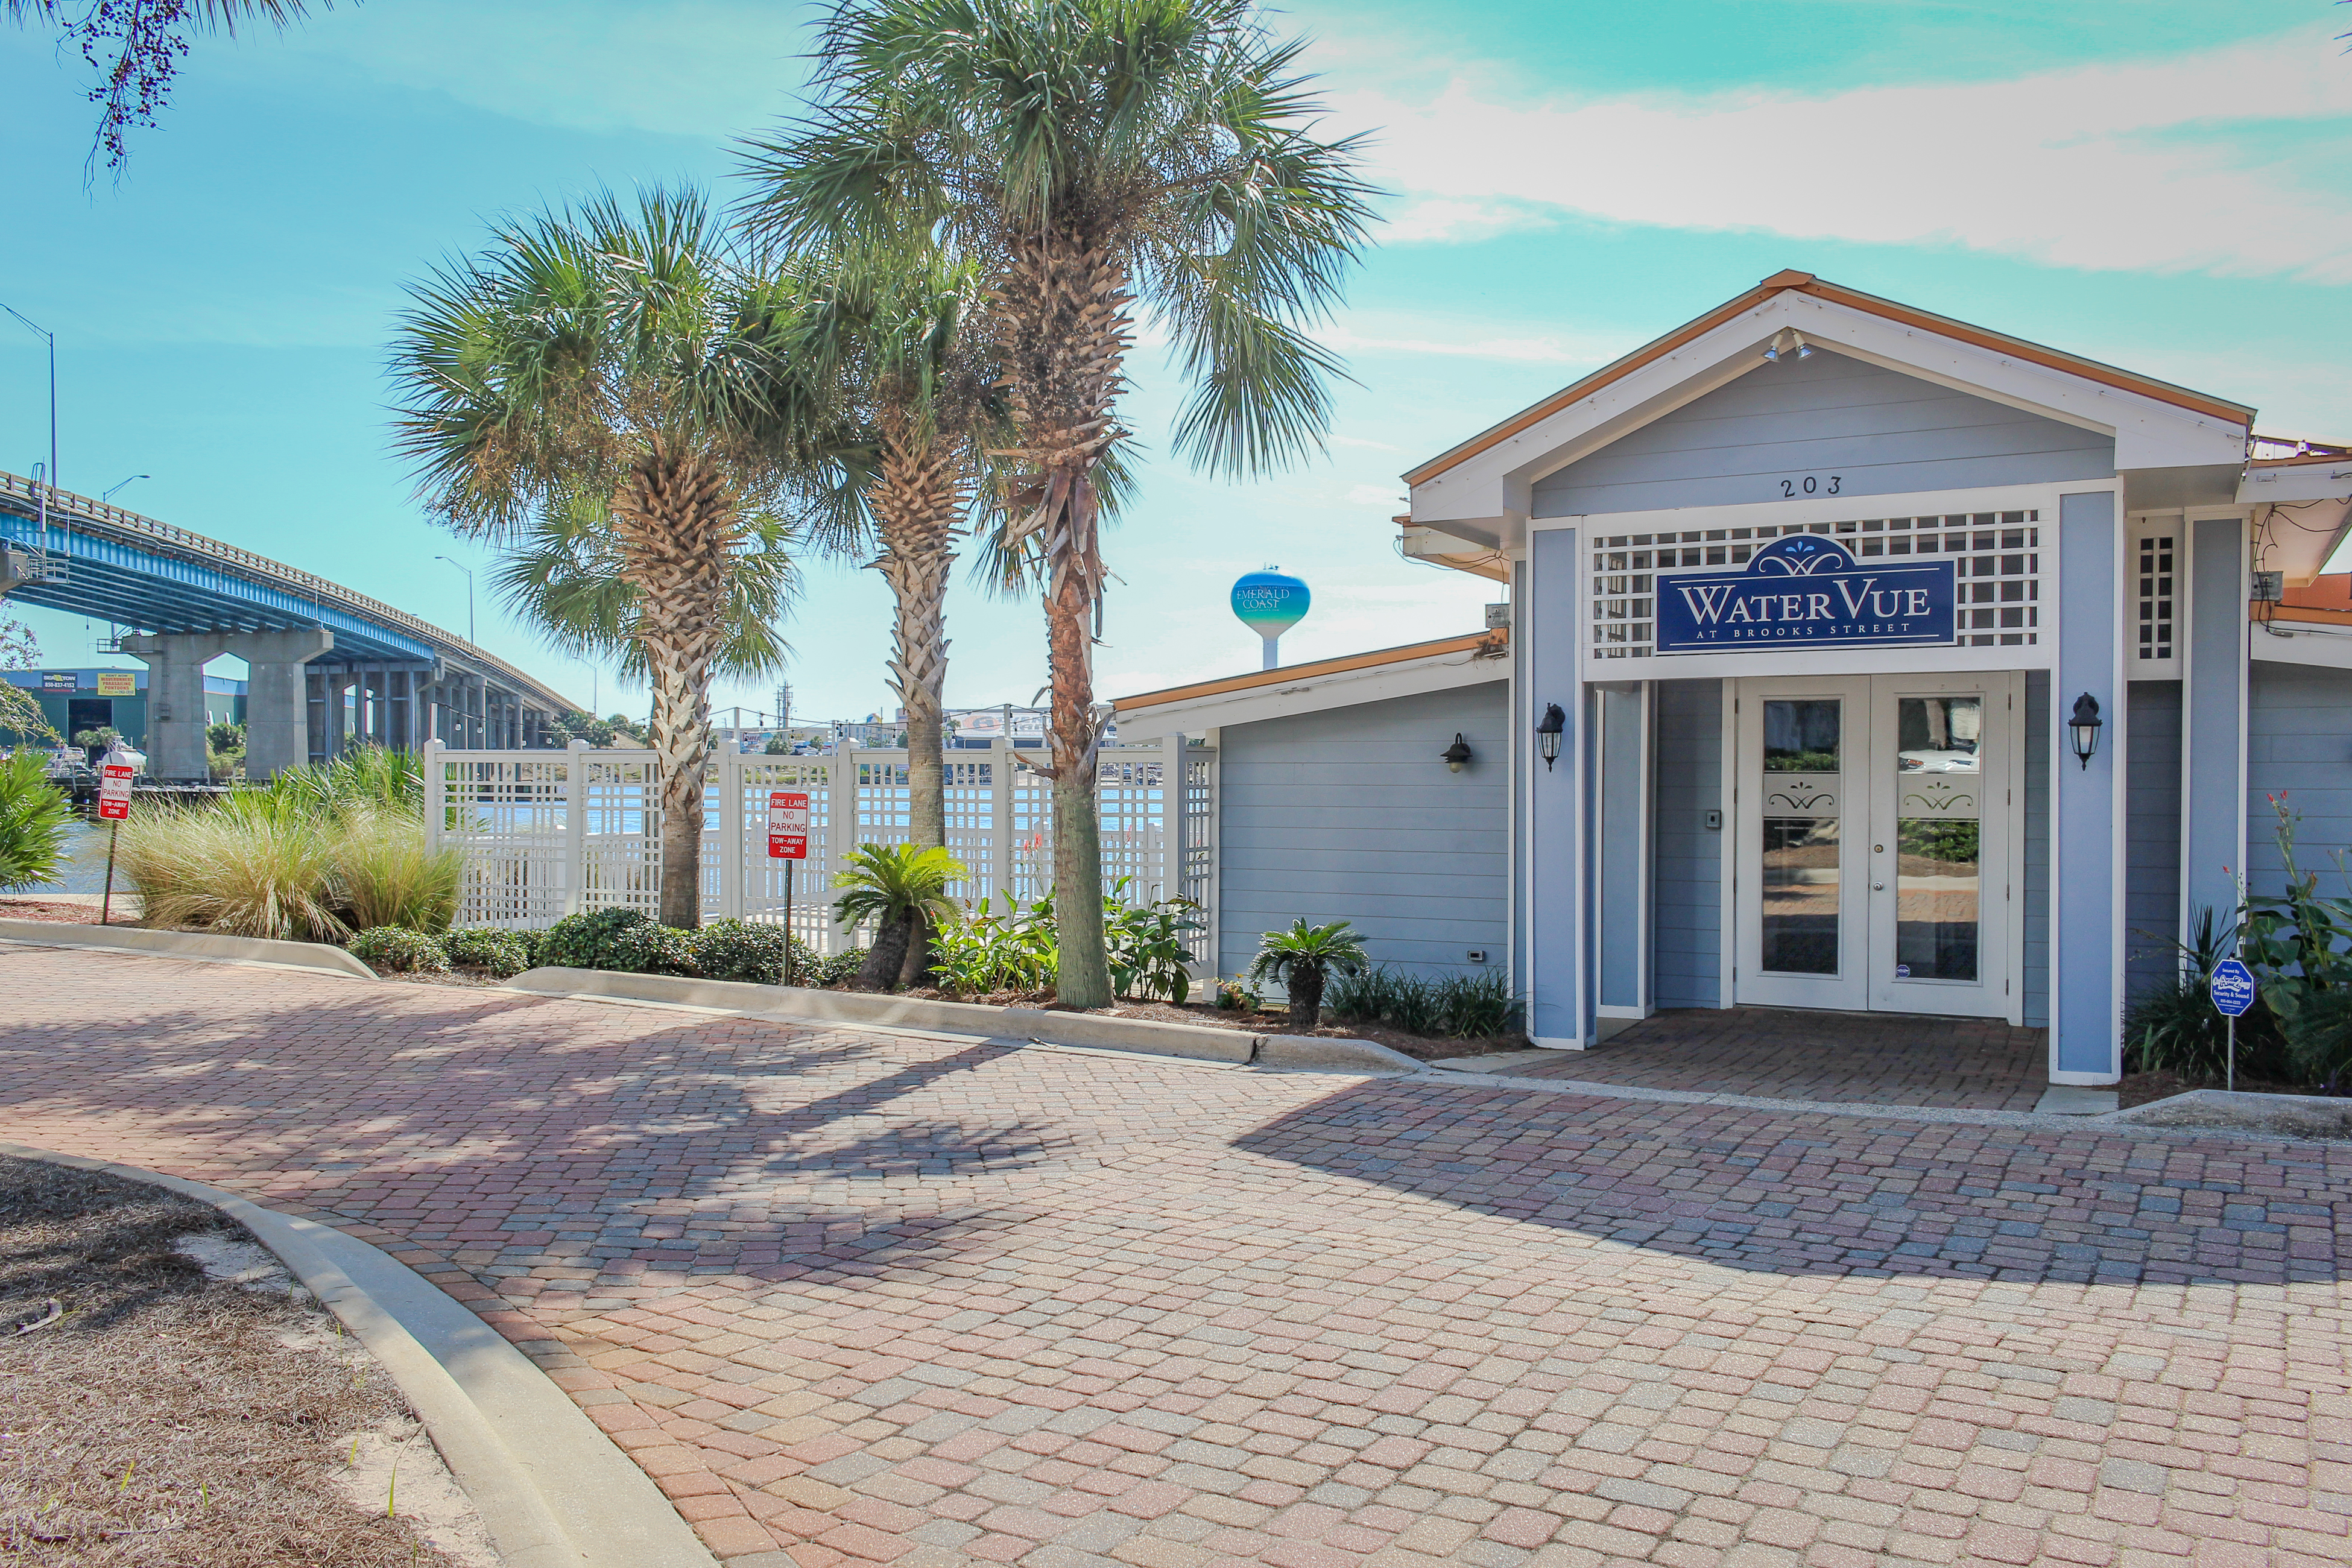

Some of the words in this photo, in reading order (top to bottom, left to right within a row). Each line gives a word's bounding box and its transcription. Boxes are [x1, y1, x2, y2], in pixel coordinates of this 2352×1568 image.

[1780, 476, 1842, 498] 203
[1237, 589, 1290, 599] EMERALD
[1243, 599, 1280, 609] COAST
[1697, 630, 1717, 639] AT
[1734, 627, 1813, 637] BROOKS
[1830, 623, 1910, 634] STREET
[103, 789, 129, 798] PARKING
[788, 799, 807, 808] LANE
[783, 811, 794, 820] NO
[771, 822, 806, 832] PARKING
